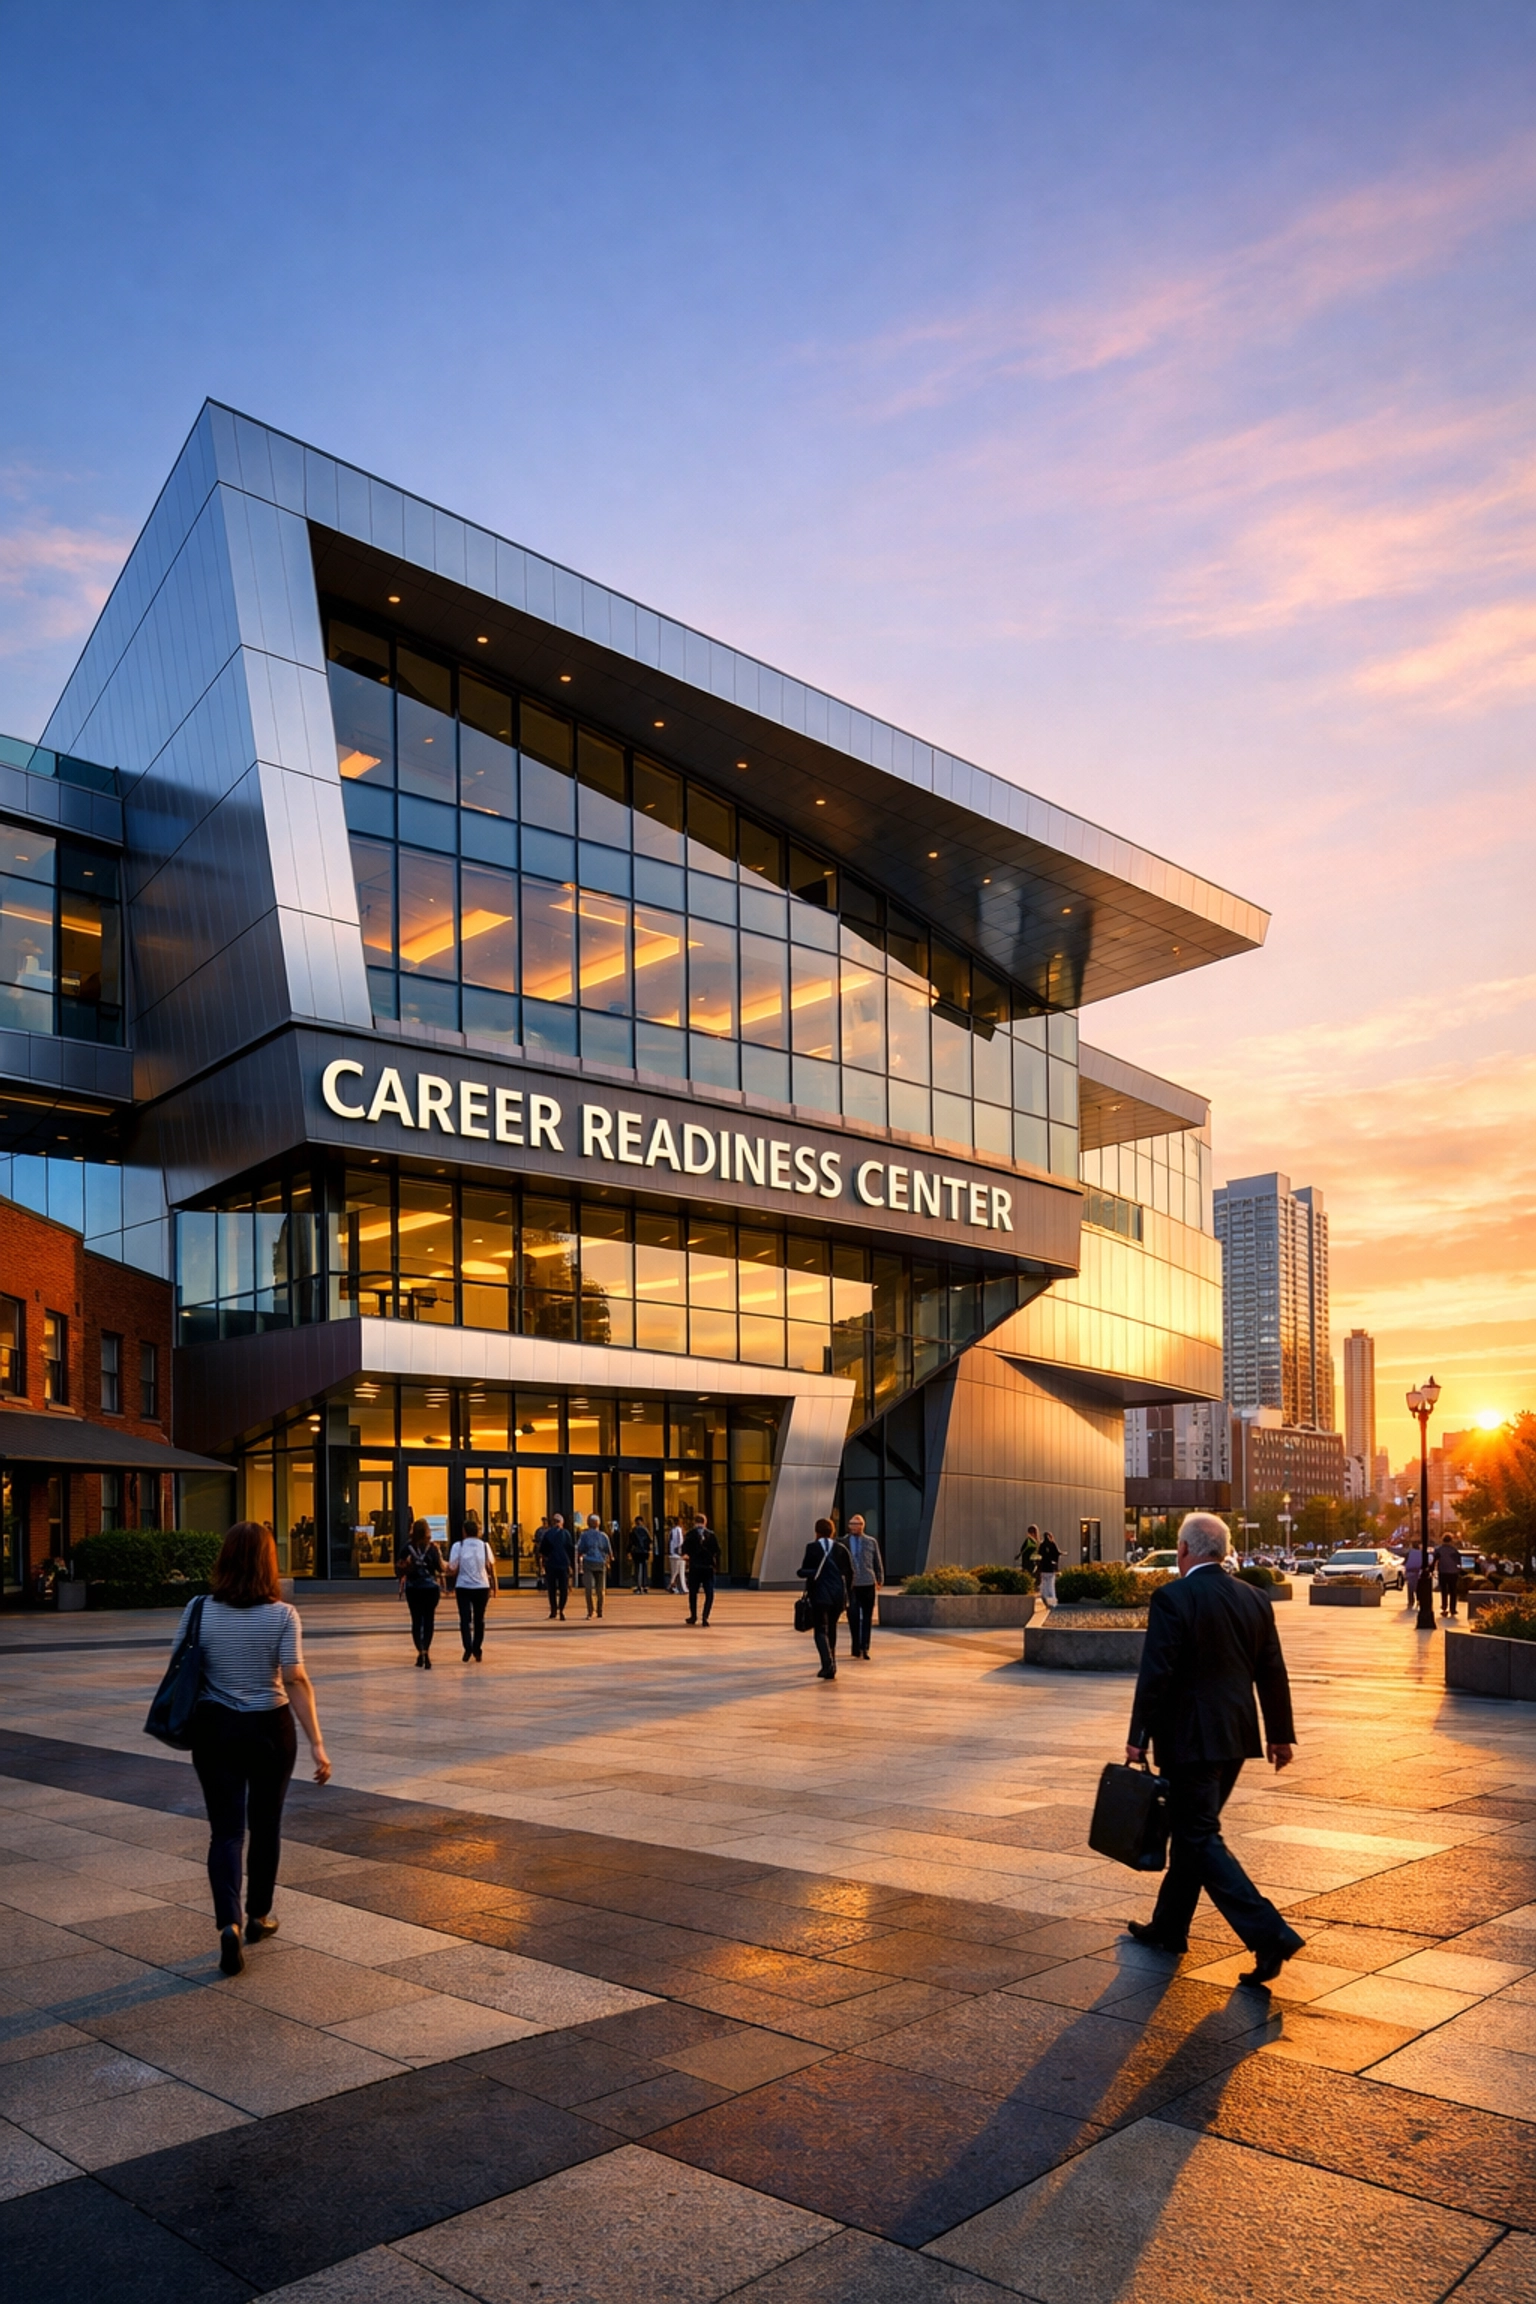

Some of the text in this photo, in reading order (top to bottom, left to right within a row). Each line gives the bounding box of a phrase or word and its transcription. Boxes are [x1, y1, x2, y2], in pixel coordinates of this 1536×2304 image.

[321, 1058, 1014, 1232] CAREER READINESS CENTER
